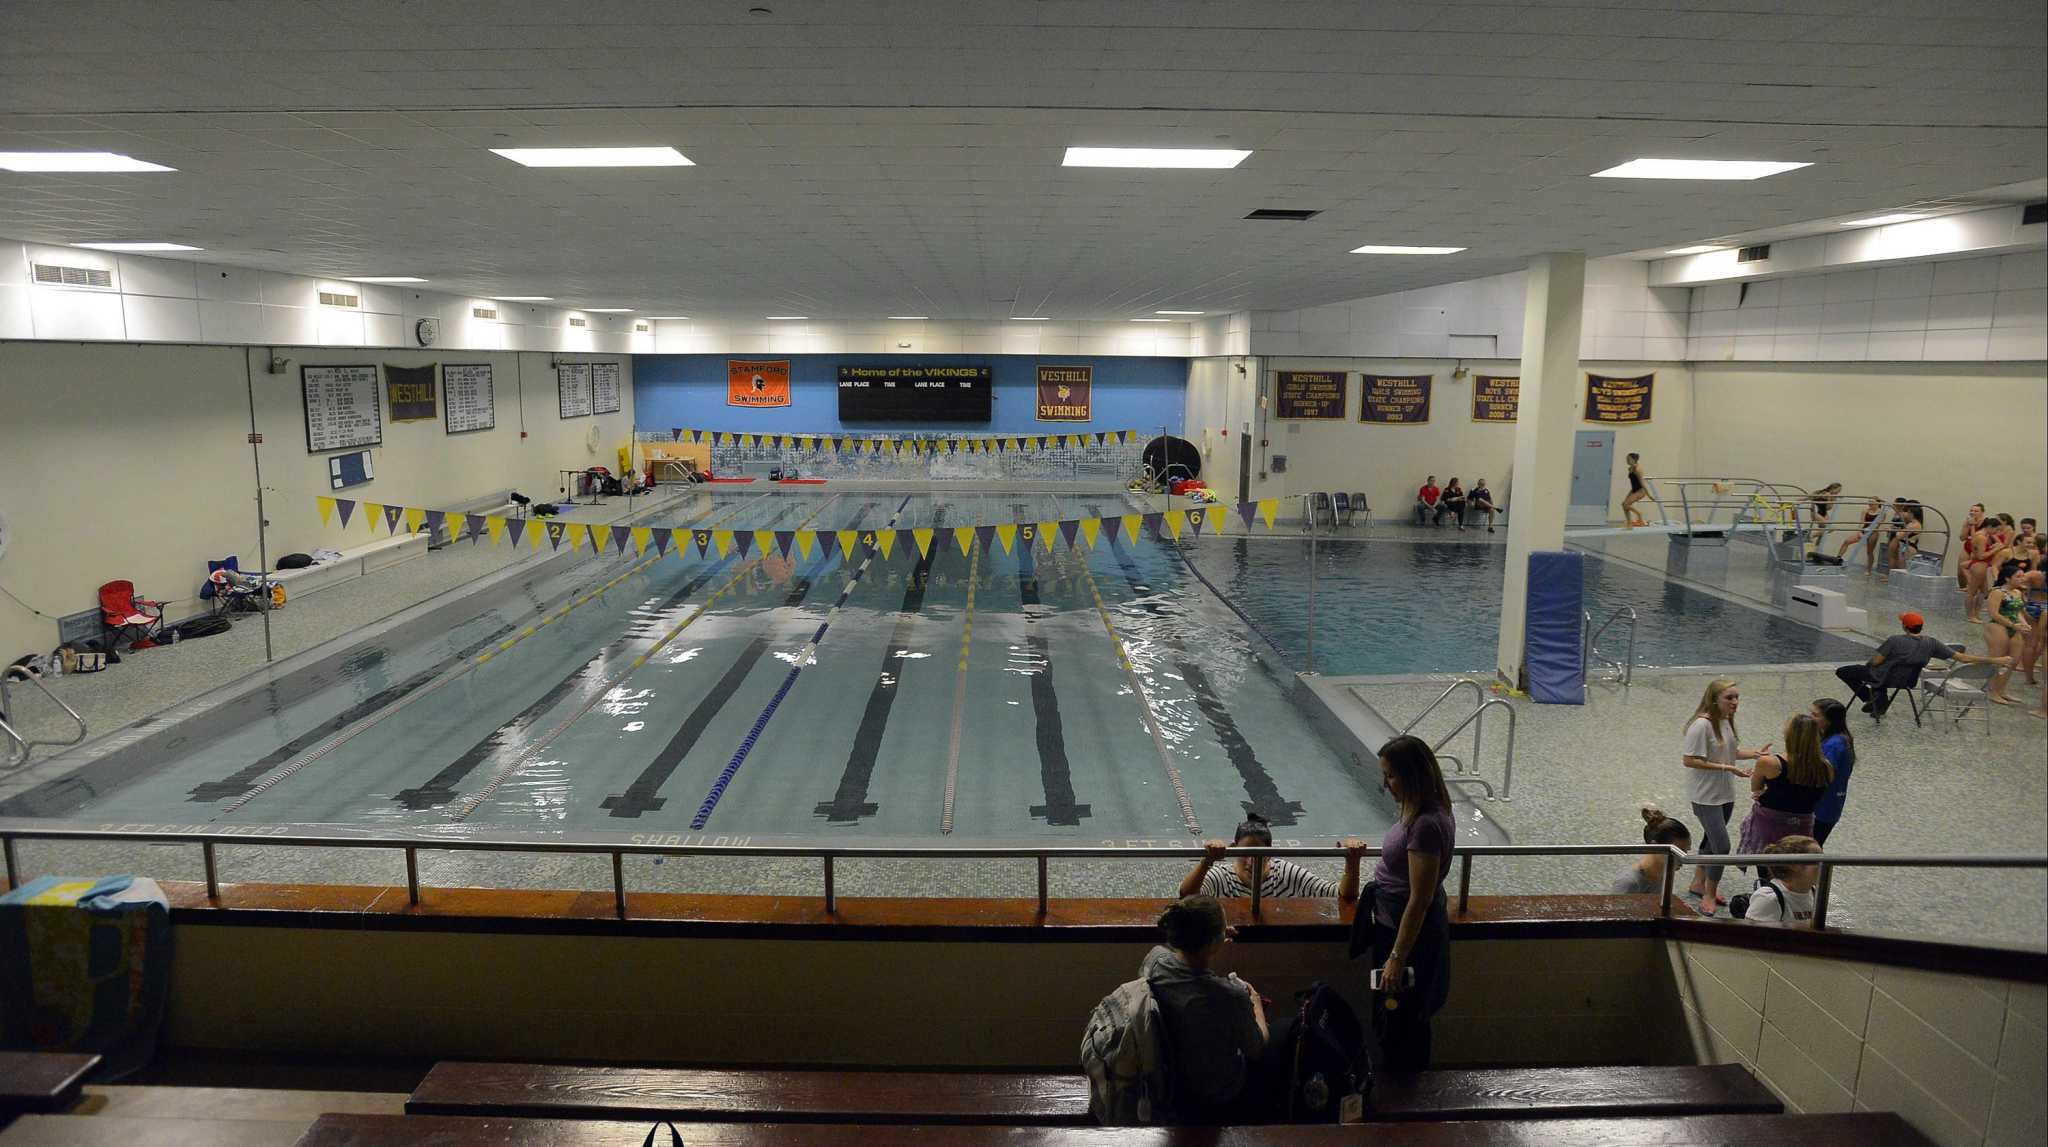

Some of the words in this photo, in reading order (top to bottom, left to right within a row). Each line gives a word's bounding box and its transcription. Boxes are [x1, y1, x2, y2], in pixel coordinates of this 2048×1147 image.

[730, 366, 788, 375] STAMFORD
[852, 368, 886, 377] Home
[888, 368, 900, 377] of
[902, 368, 923, 377] the
[1040, 371, 1088, 382] WESTHILL
[1292, 374, 1333, 383] WESTHILL
[1377, 379, 1418, 387] WESTHILL
[1489, 379, 1520, 387] WESTHI
[390, 383, 435, 403] WESTHILL
[735, 394, 785, 403] SWIMMING
[1040, 405, 1087, 417] SWIMMING
[1190, 511, 1201, 525] 6
[551, 526, 560, 538] 2
[1023, 526, 1033, 540] 5
[698, 532, 708, 546] 3
[862, 534, 874, 546] 4
[630, 833, 751, 847] SHALLOW
